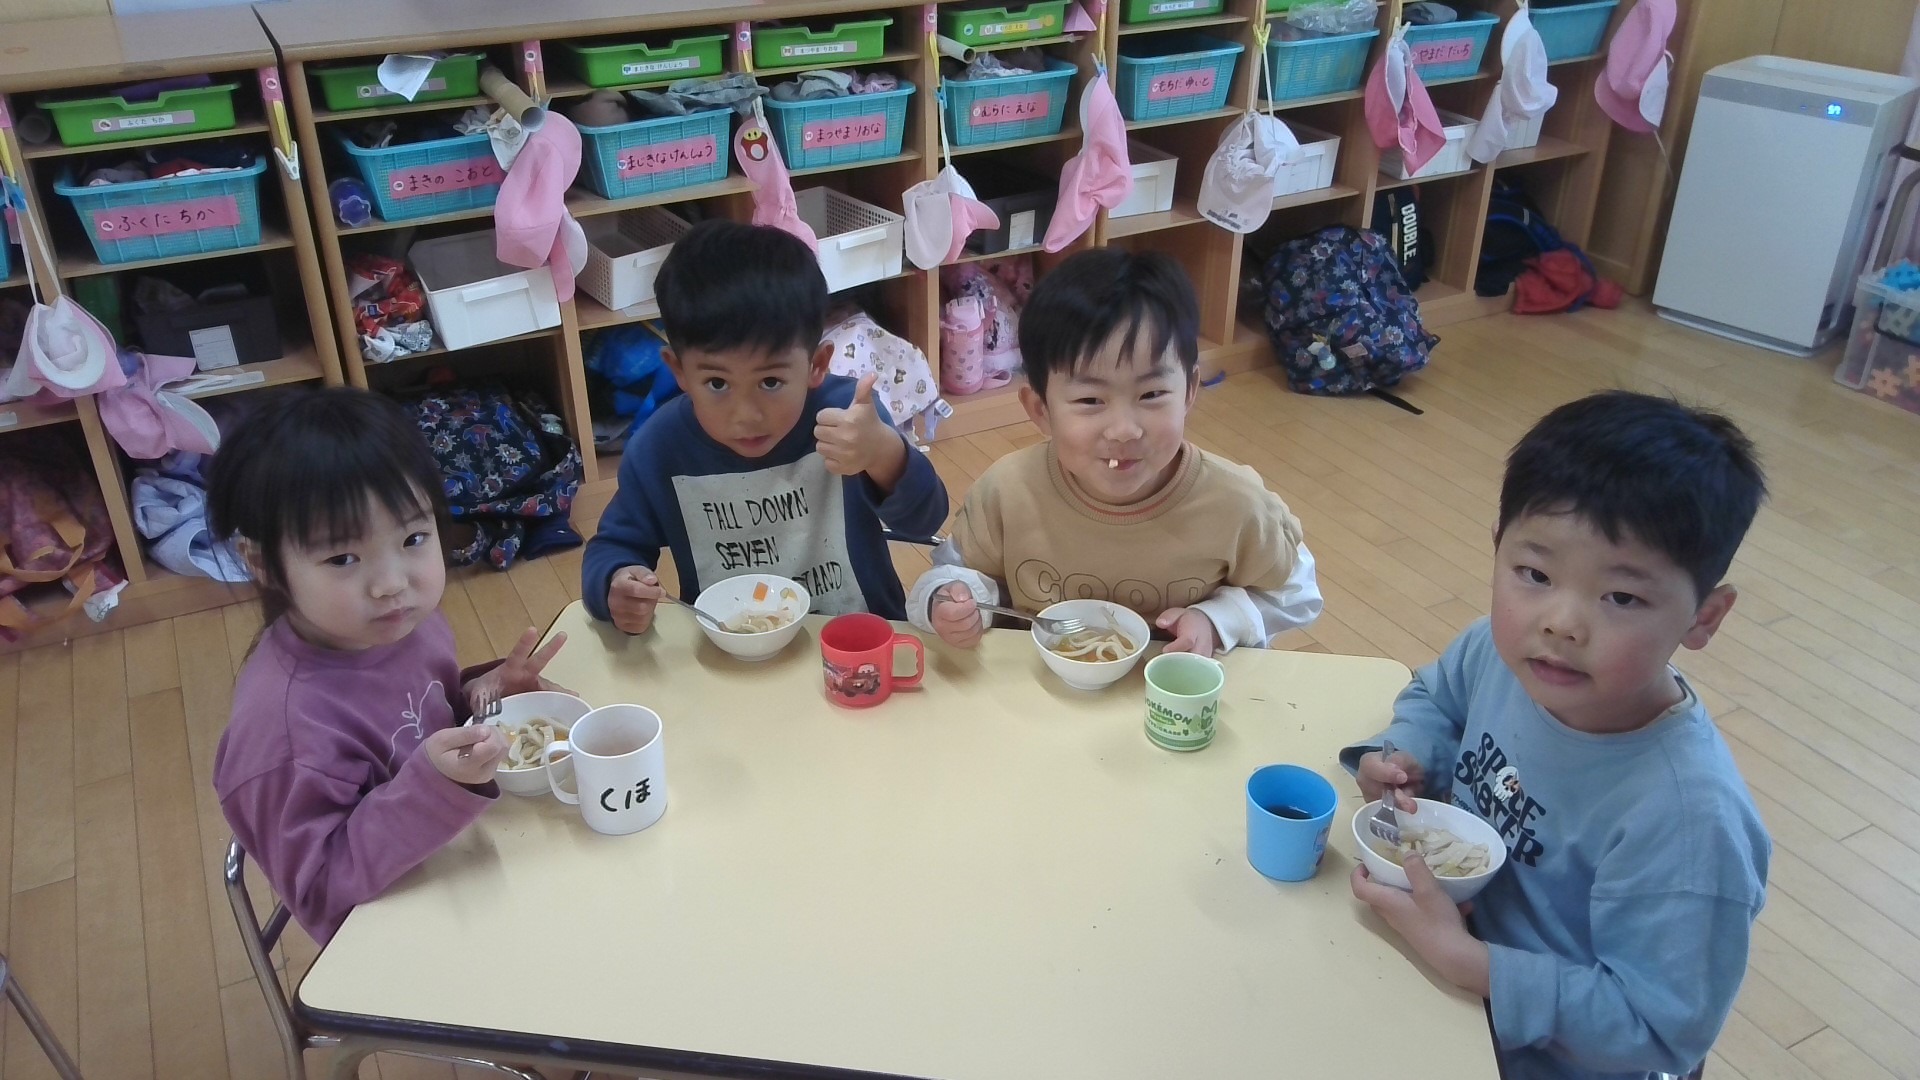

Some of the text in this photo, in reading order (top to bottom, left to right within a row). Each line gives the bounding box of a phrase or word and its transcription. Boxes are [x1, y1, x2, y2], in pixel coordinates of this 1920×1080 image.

[816, 122, 881, 143] まつやま りおな
[407, 165, 493, 192] まきの こおと
[180, 208, 216, 225] ちか
[703, 487, 809, 531] FALL DOWN
[715, 536, 780, 570] SEVEN
[792, 561, 843, 598] TAND
[600, 777, 651, 813] くほ
[1478, 732, 1546, 837] SPCE
